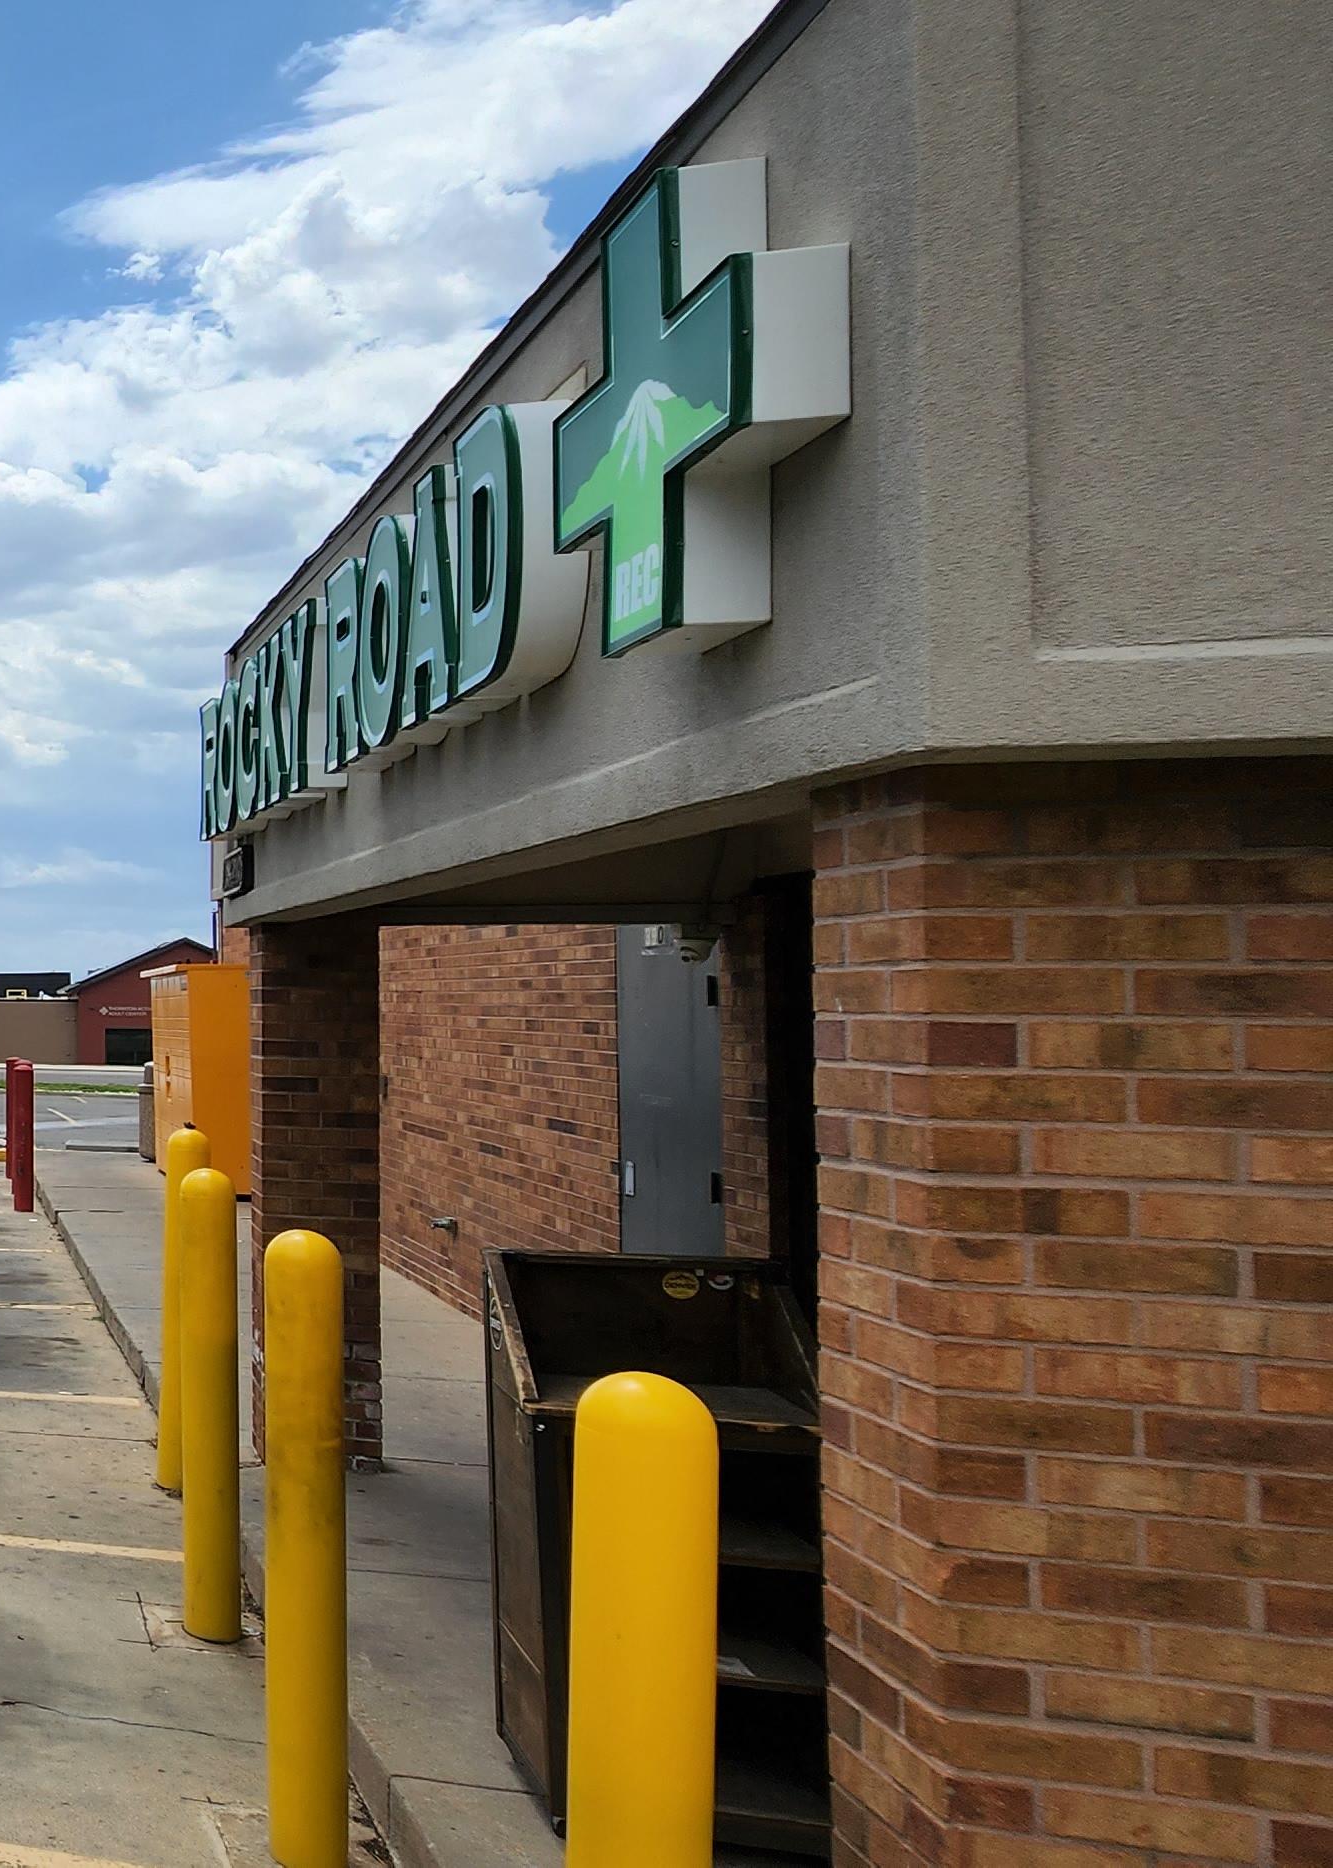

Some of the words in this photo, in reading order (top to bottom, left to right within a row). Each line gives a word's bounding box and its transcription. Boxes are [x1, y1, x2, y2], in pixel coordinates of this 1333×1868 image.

[200, 598, 317, 841] ROCKY
[325, 405, 523, 774] ROAD
[614, 544, 661, 622] REC
